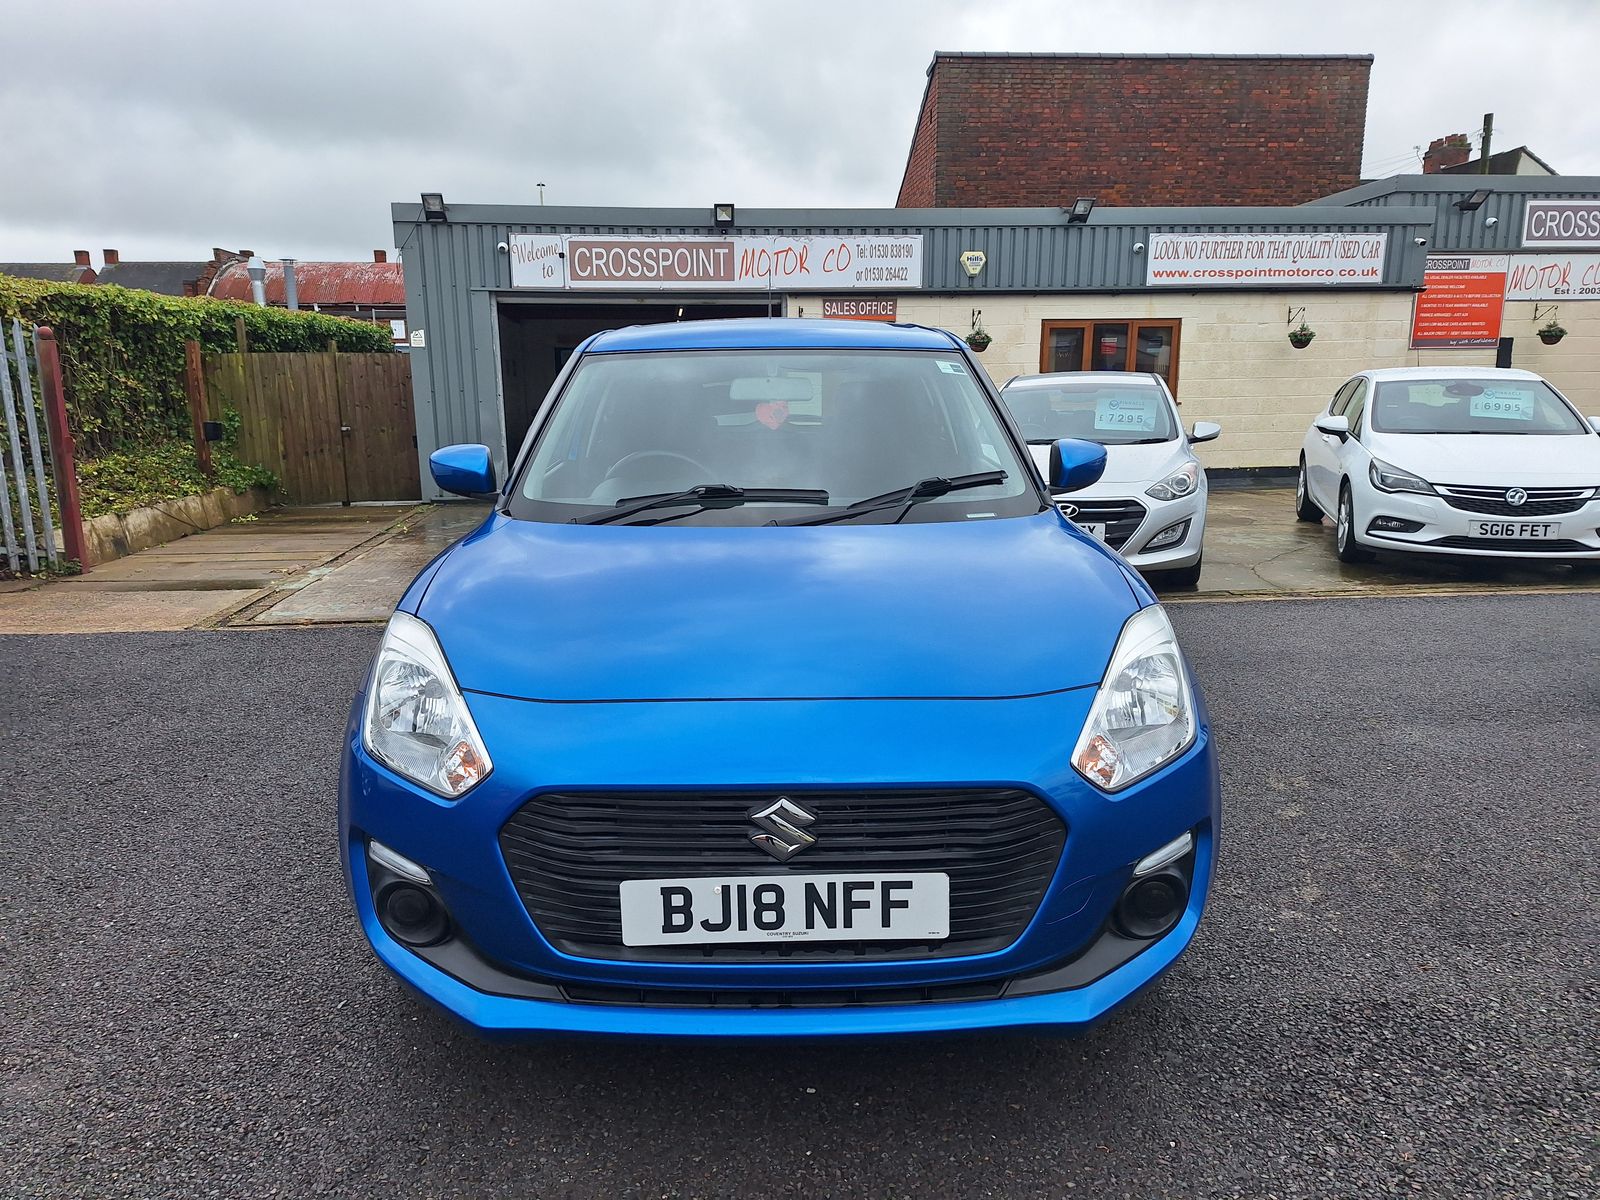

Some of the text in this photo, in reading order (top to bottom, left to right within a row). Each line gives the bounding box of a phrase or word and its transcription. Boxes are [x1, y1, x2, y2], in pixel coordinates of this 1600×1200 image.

[511, 241, 560, 264] Welcome
[856, 244, 913, 259] Tel: 01530 838190
[1154, 240, 1381, 264] LOOK NO FURTHER FOR THAT QUALITY USED CAR
[542, 263, 554, 279] to
[575, 243, 851, 280] CROSSPOINT MOTOR CO
[856, 267, 908, 281] or 01530 264422
[1508, 261, 1572, 293] MOTOR
[824, 301, 894, 316] SALES OFFICE
[1479, 522, 1552, 537] SG16 FET
[660, 880, 914, 934] BJ18 NFF
